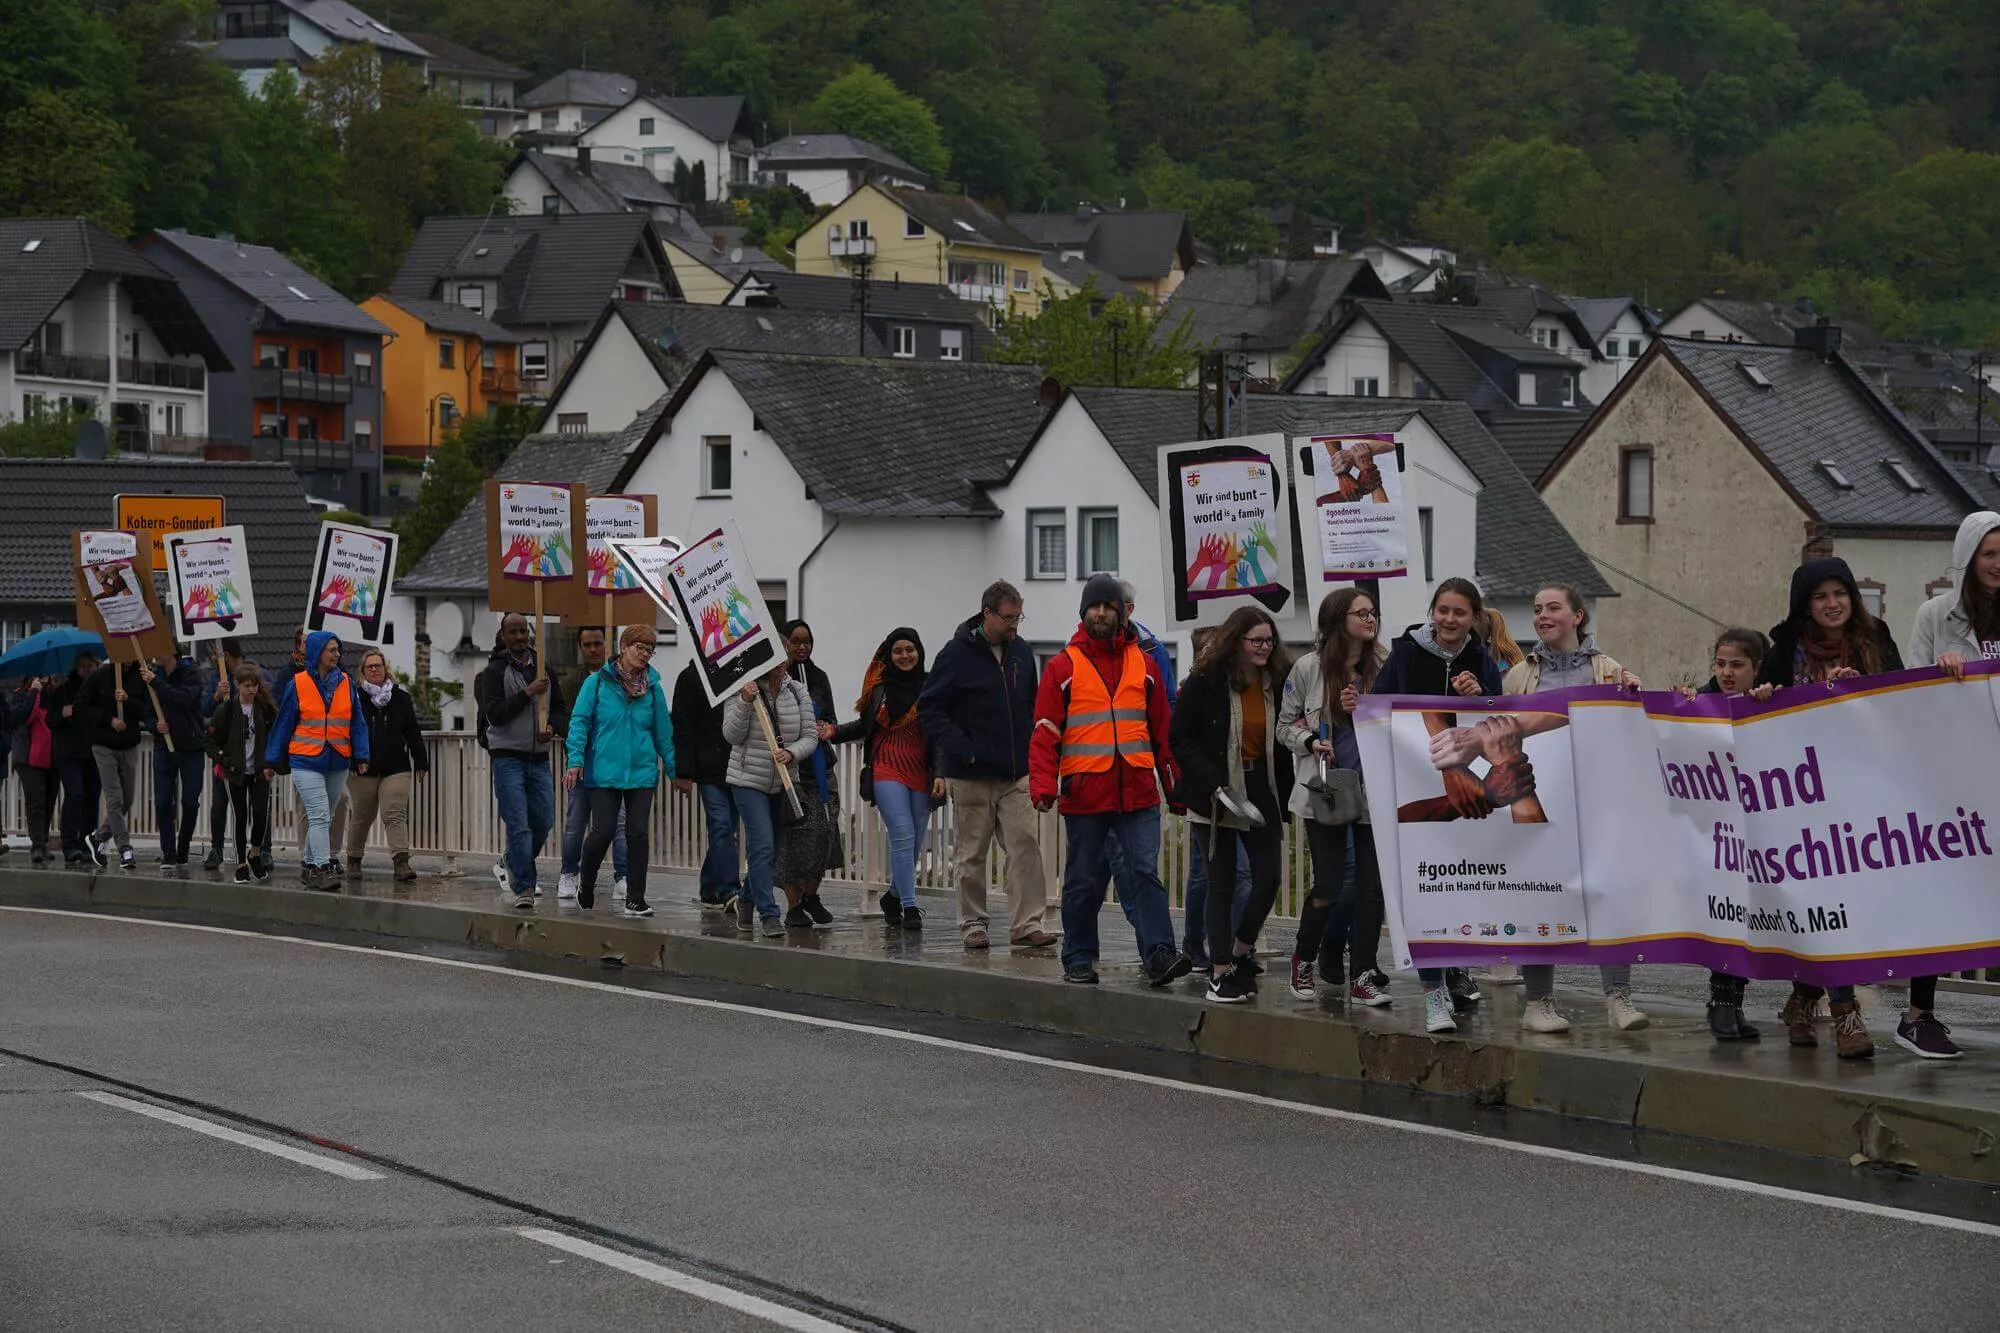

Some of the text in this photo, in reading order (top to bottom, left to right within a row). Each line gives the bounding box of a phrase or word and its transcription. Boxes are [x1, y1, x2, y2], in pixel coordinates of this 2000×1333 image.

[1196, 493, 1212, 505] Wir
[1215, 490, 1231, 502] sind
[1232, 489, 1258, 502] bunt
[510, 504, 523, 513] Wir
[525, 505, 537, 513] sind
[538, 505, 558, 515] bunt
[1193, 507, 1265, 524] world is a family
[127, 515, 215, 529] Kobern-Gondorf
[507, 517, 530, 527] world
[542, 519, 563, 529] family
[586, 518, 599, 527] Wir
[600, 518, 612, 526] sind
[613, 518, 632, 527] bunt
[88, 547, 99, 555] Wir
[110, 547, 126, 555] bunt
[337, 548, 348, 557] Wir
[358, 552, 375, 563] bunt
[186, 560, 197, 568] Wir
[207, 558, 225, 567] bunt
[332, 560, 351, 569] world
[360, 565, 377, 575] family
[185, 569, 204, 579] world
[213, 569, 230, 577] family
[686, 577, 698, 589] Wir
[698, 569, 708, 581] sind
[706, 560, 724, 576] bunt
[690, 585, 708, 604] world
[715, 571, 732, 587] family
[1738, 746, 1825, 813] and
[1713, 806, 1992, 884] für nschlichkeit
[1418, 859, 1507, 881] #goodnews
[1419, 880, 1563, 893] Hand in Hand für Menschlichkeit
[1786, 911, 1805, 934] 8.
[1807, 902, 1848, 933] Mai
